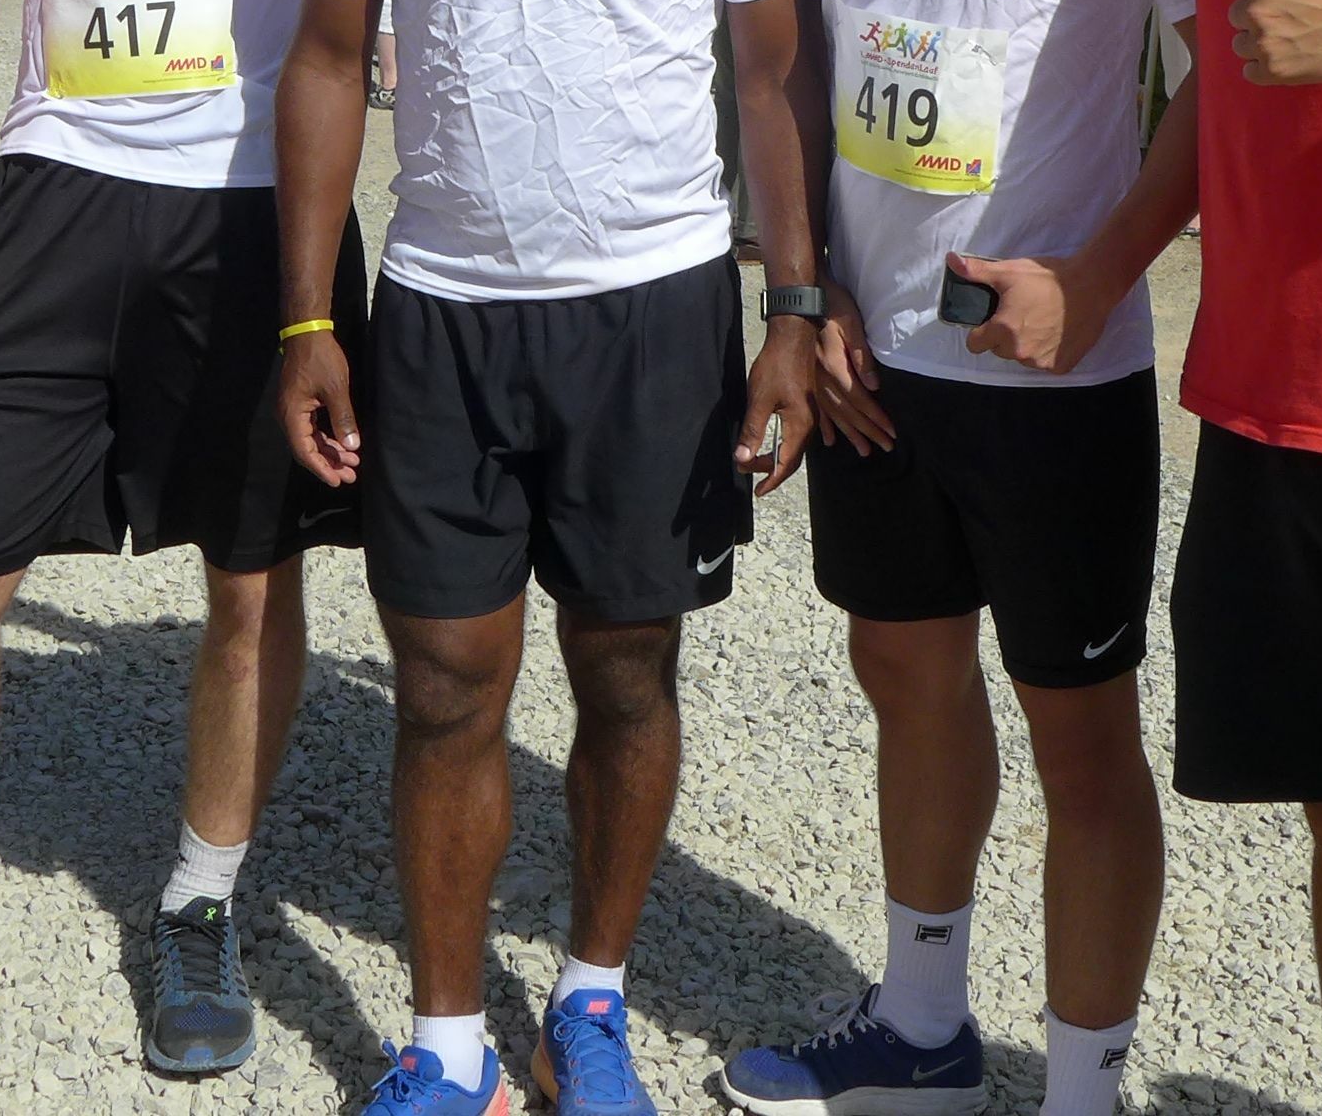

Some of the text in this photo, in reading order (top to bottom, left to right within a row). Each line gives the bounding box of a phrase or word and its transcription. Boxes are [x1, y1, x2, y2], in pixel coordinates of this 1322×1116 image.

[83, 1, 176, 59] 417
[164, 57, 207, 72] MMD
[855, 76, 939, 148] 419
[915, 154, 962, 171] MMD
